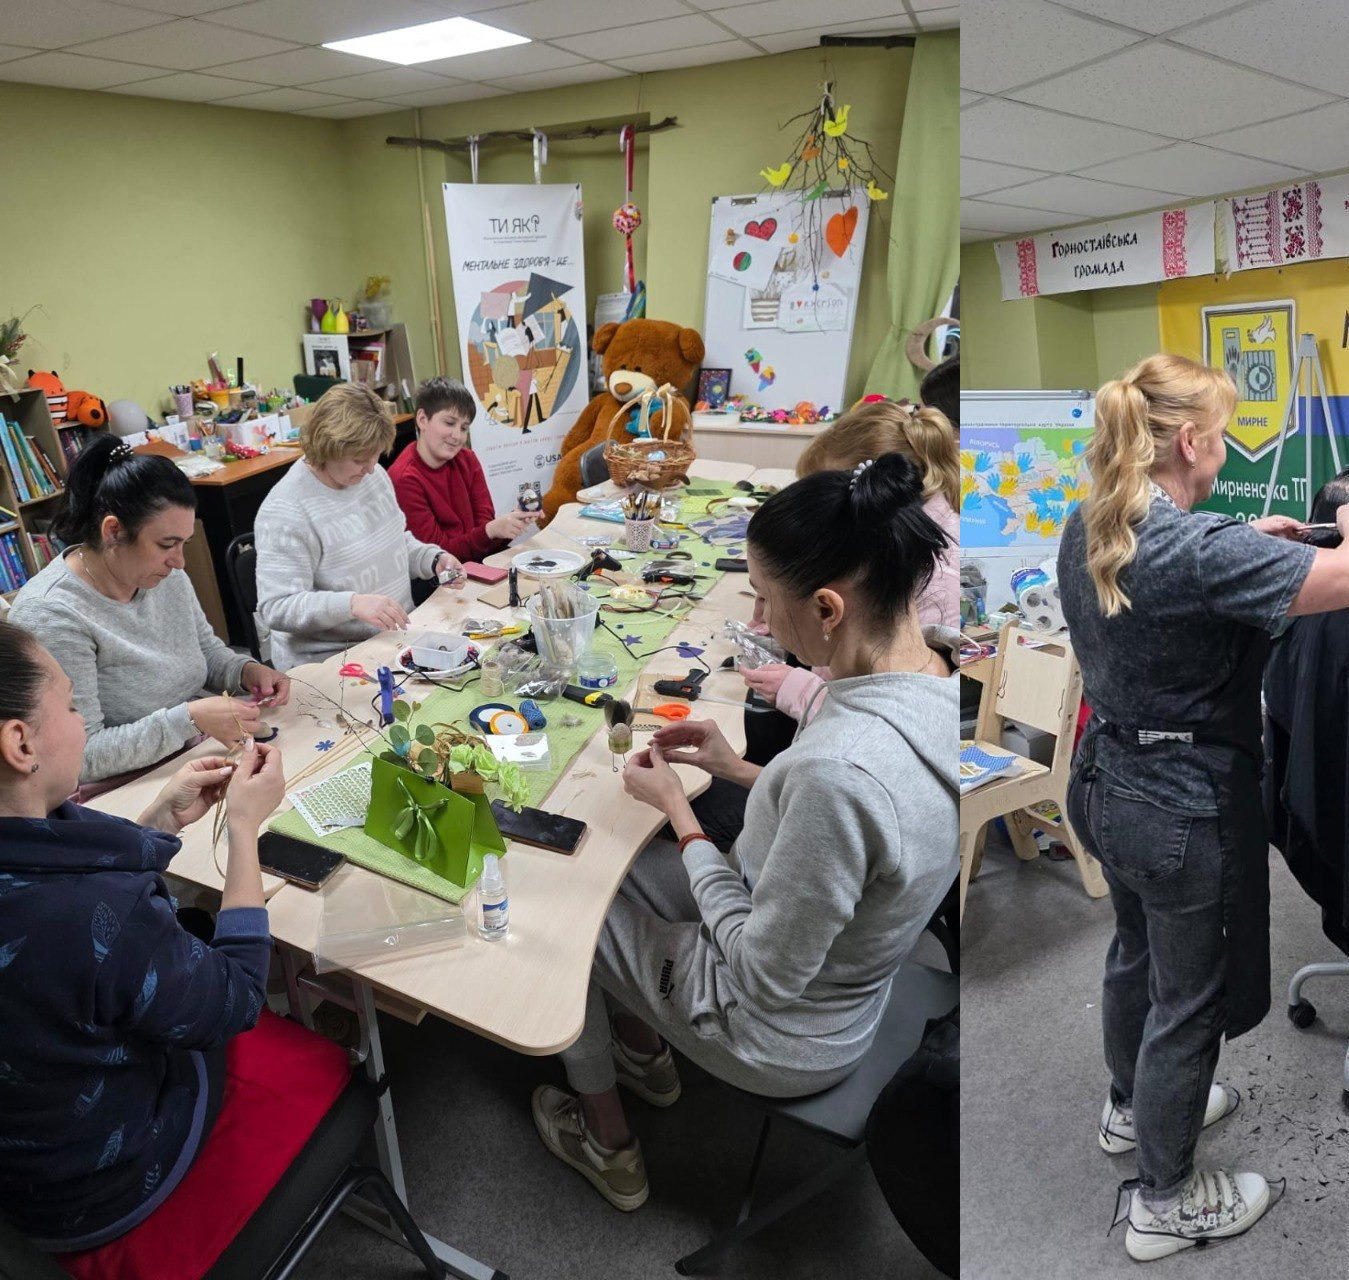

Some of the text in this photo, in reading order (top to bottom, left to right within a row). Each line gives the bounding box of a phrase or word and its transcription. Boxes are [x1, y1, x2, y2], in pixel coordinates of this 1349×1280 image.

[488, 214, 540, 234] ТИ ЯК?
[462, 258, 510, 271] МЕНТАЛЬНЕ
[1237, 416, 1269, 427] МИРНЕ
[545, 452, 563, 463] USA
[1211, 475, 1289, 503] Мирненска
